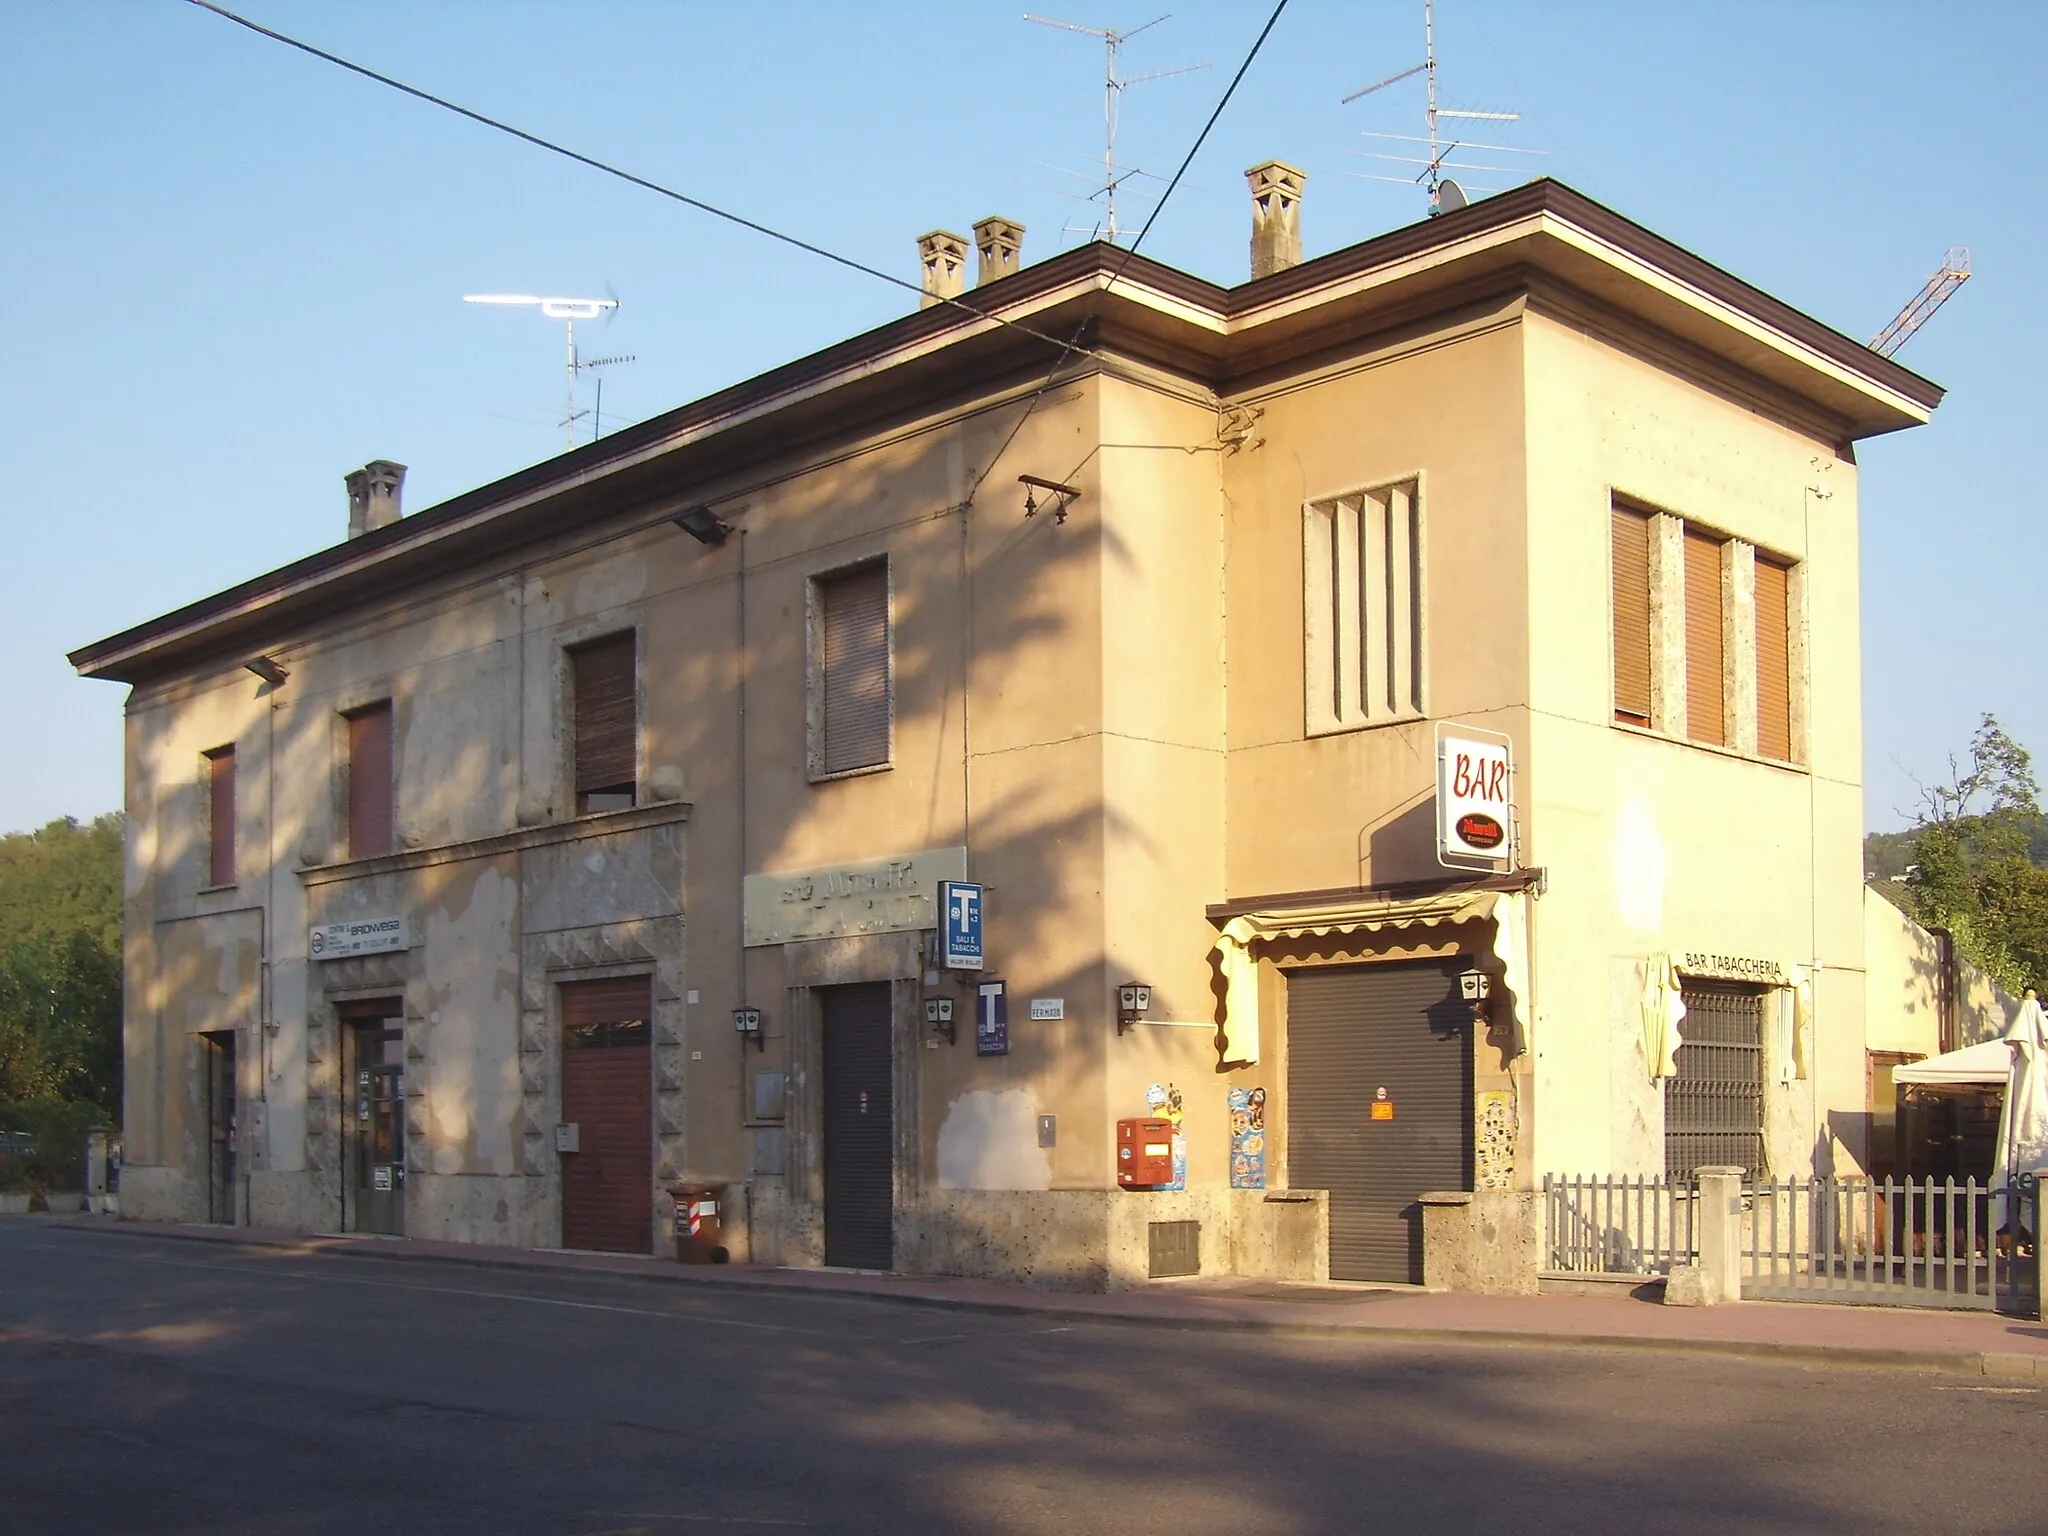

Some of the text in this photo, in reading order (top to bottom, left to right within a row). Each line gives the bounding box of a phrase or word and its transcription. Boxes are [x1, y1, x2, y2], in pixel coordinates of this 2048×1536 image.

[1453, 753, 1505, 803] BAR
[952, 889, 978, 933] T
[951, 943, 980, 952] TABACCHI
[955, 935, 970, 943] SALI
[1685, 953, 1782, 976] BAR TABACCHERIA
[980, 984, 1003, 1033] T
[1032, 1008, 1061, 1018] FERMATA
